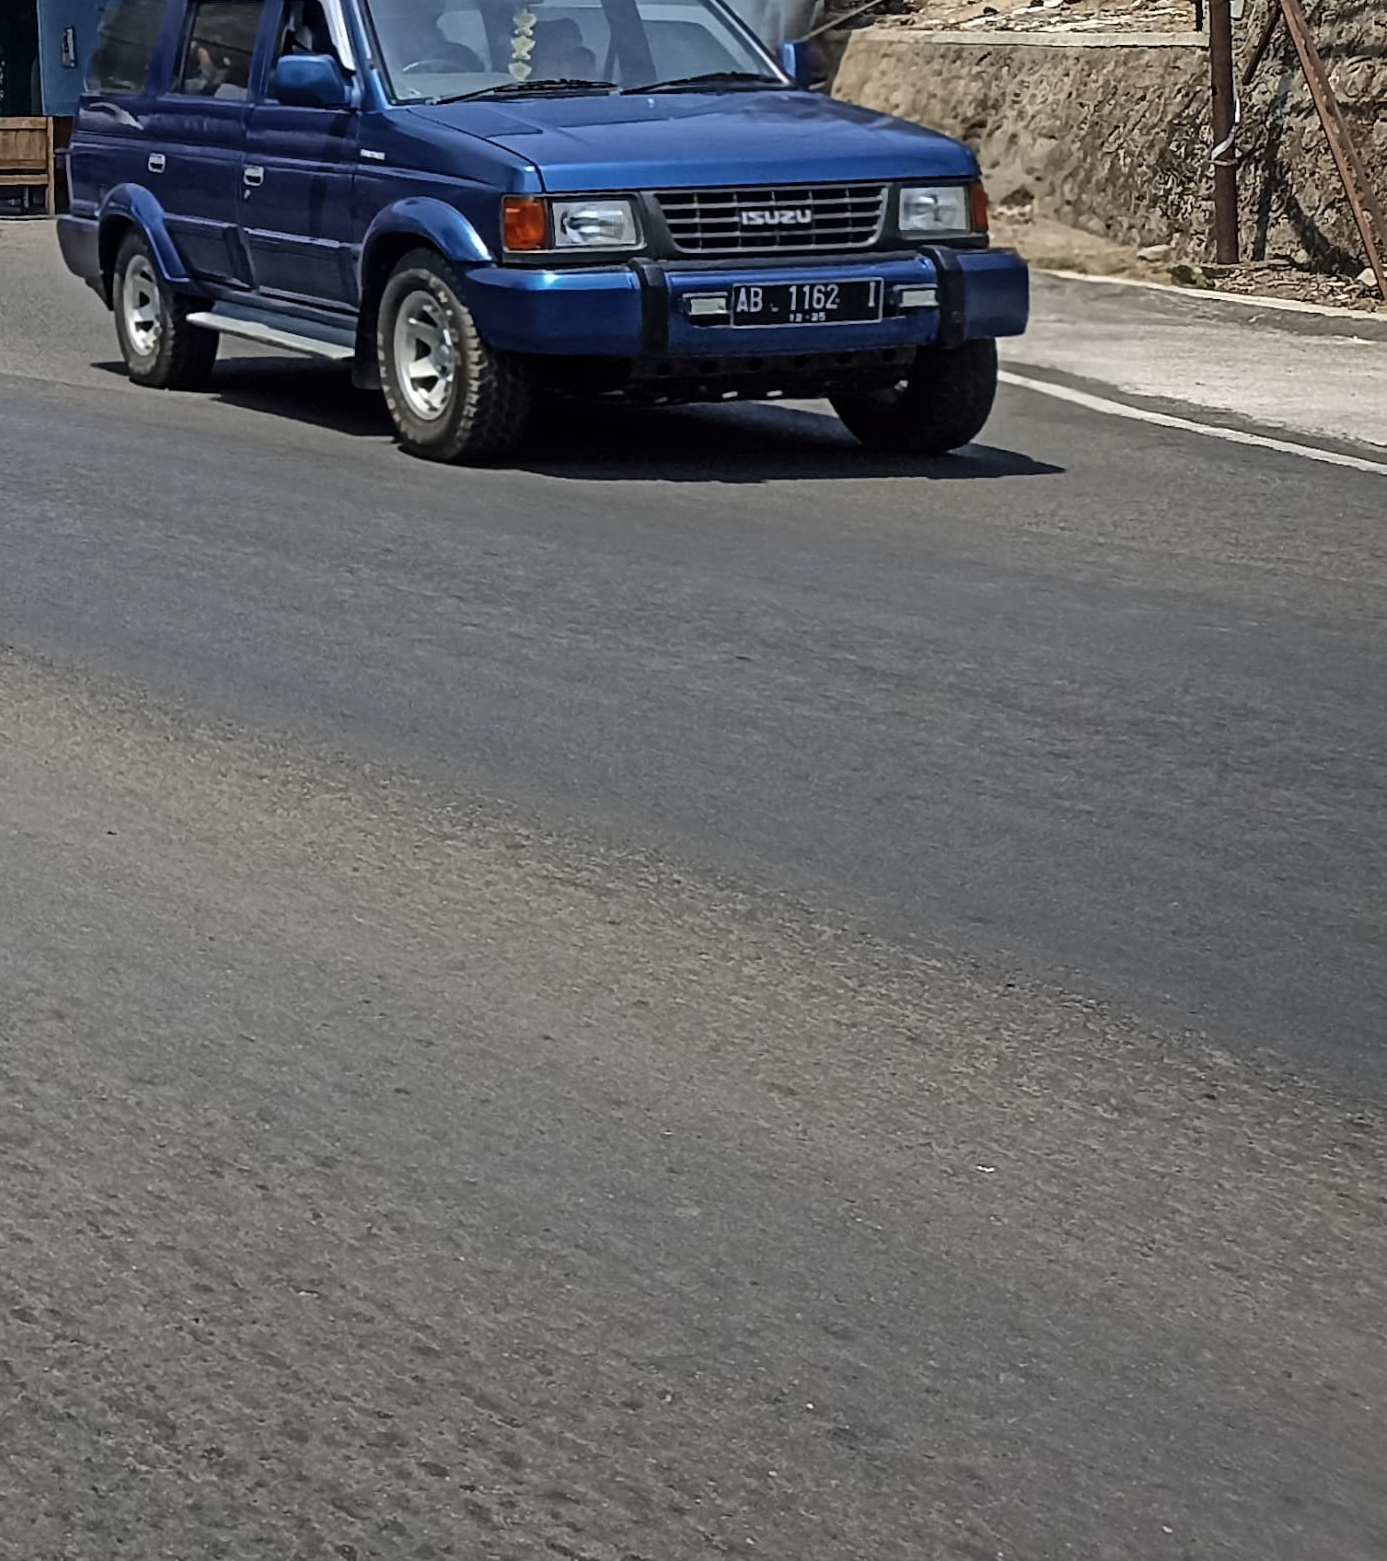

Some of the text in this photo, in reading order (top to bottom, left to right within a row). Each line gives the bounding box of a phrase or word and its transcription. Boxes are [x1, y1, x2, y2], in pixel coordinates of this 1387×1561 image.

[741, 209, 812, 225] ISUZU
[736, 287, 763, 313] AB
[789, 284, 839, 311] 1162
